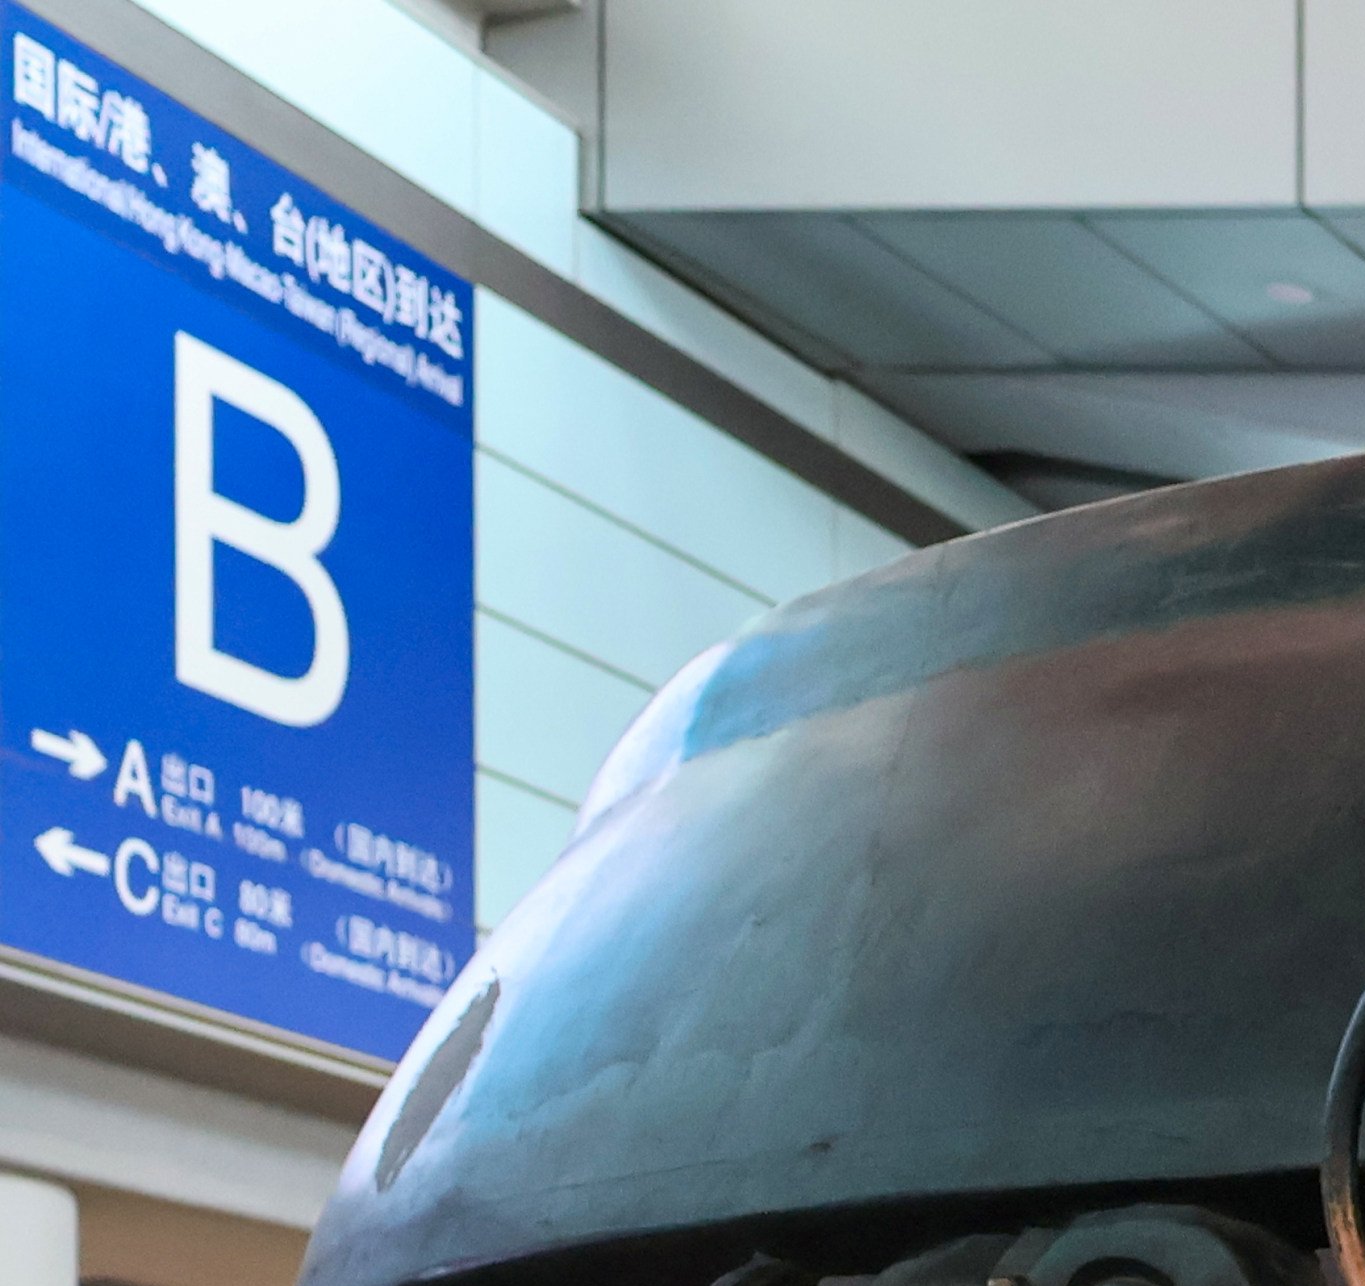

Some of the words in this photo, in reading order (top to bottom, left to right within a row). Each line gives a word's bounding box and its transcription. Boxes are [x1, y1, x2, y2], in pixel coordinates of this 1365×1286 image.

[174, 329, 350, 728] B
[114, 739, 157, 819] A
[161, 752, 215, 807] 出口
[161, 793, 202, 835] Exit
[114, 837, 160, 915] C
[162, 851, 216, 902] 出口
[162, 892, 199, 930] Exit
[204, 906, 225, 940] C
